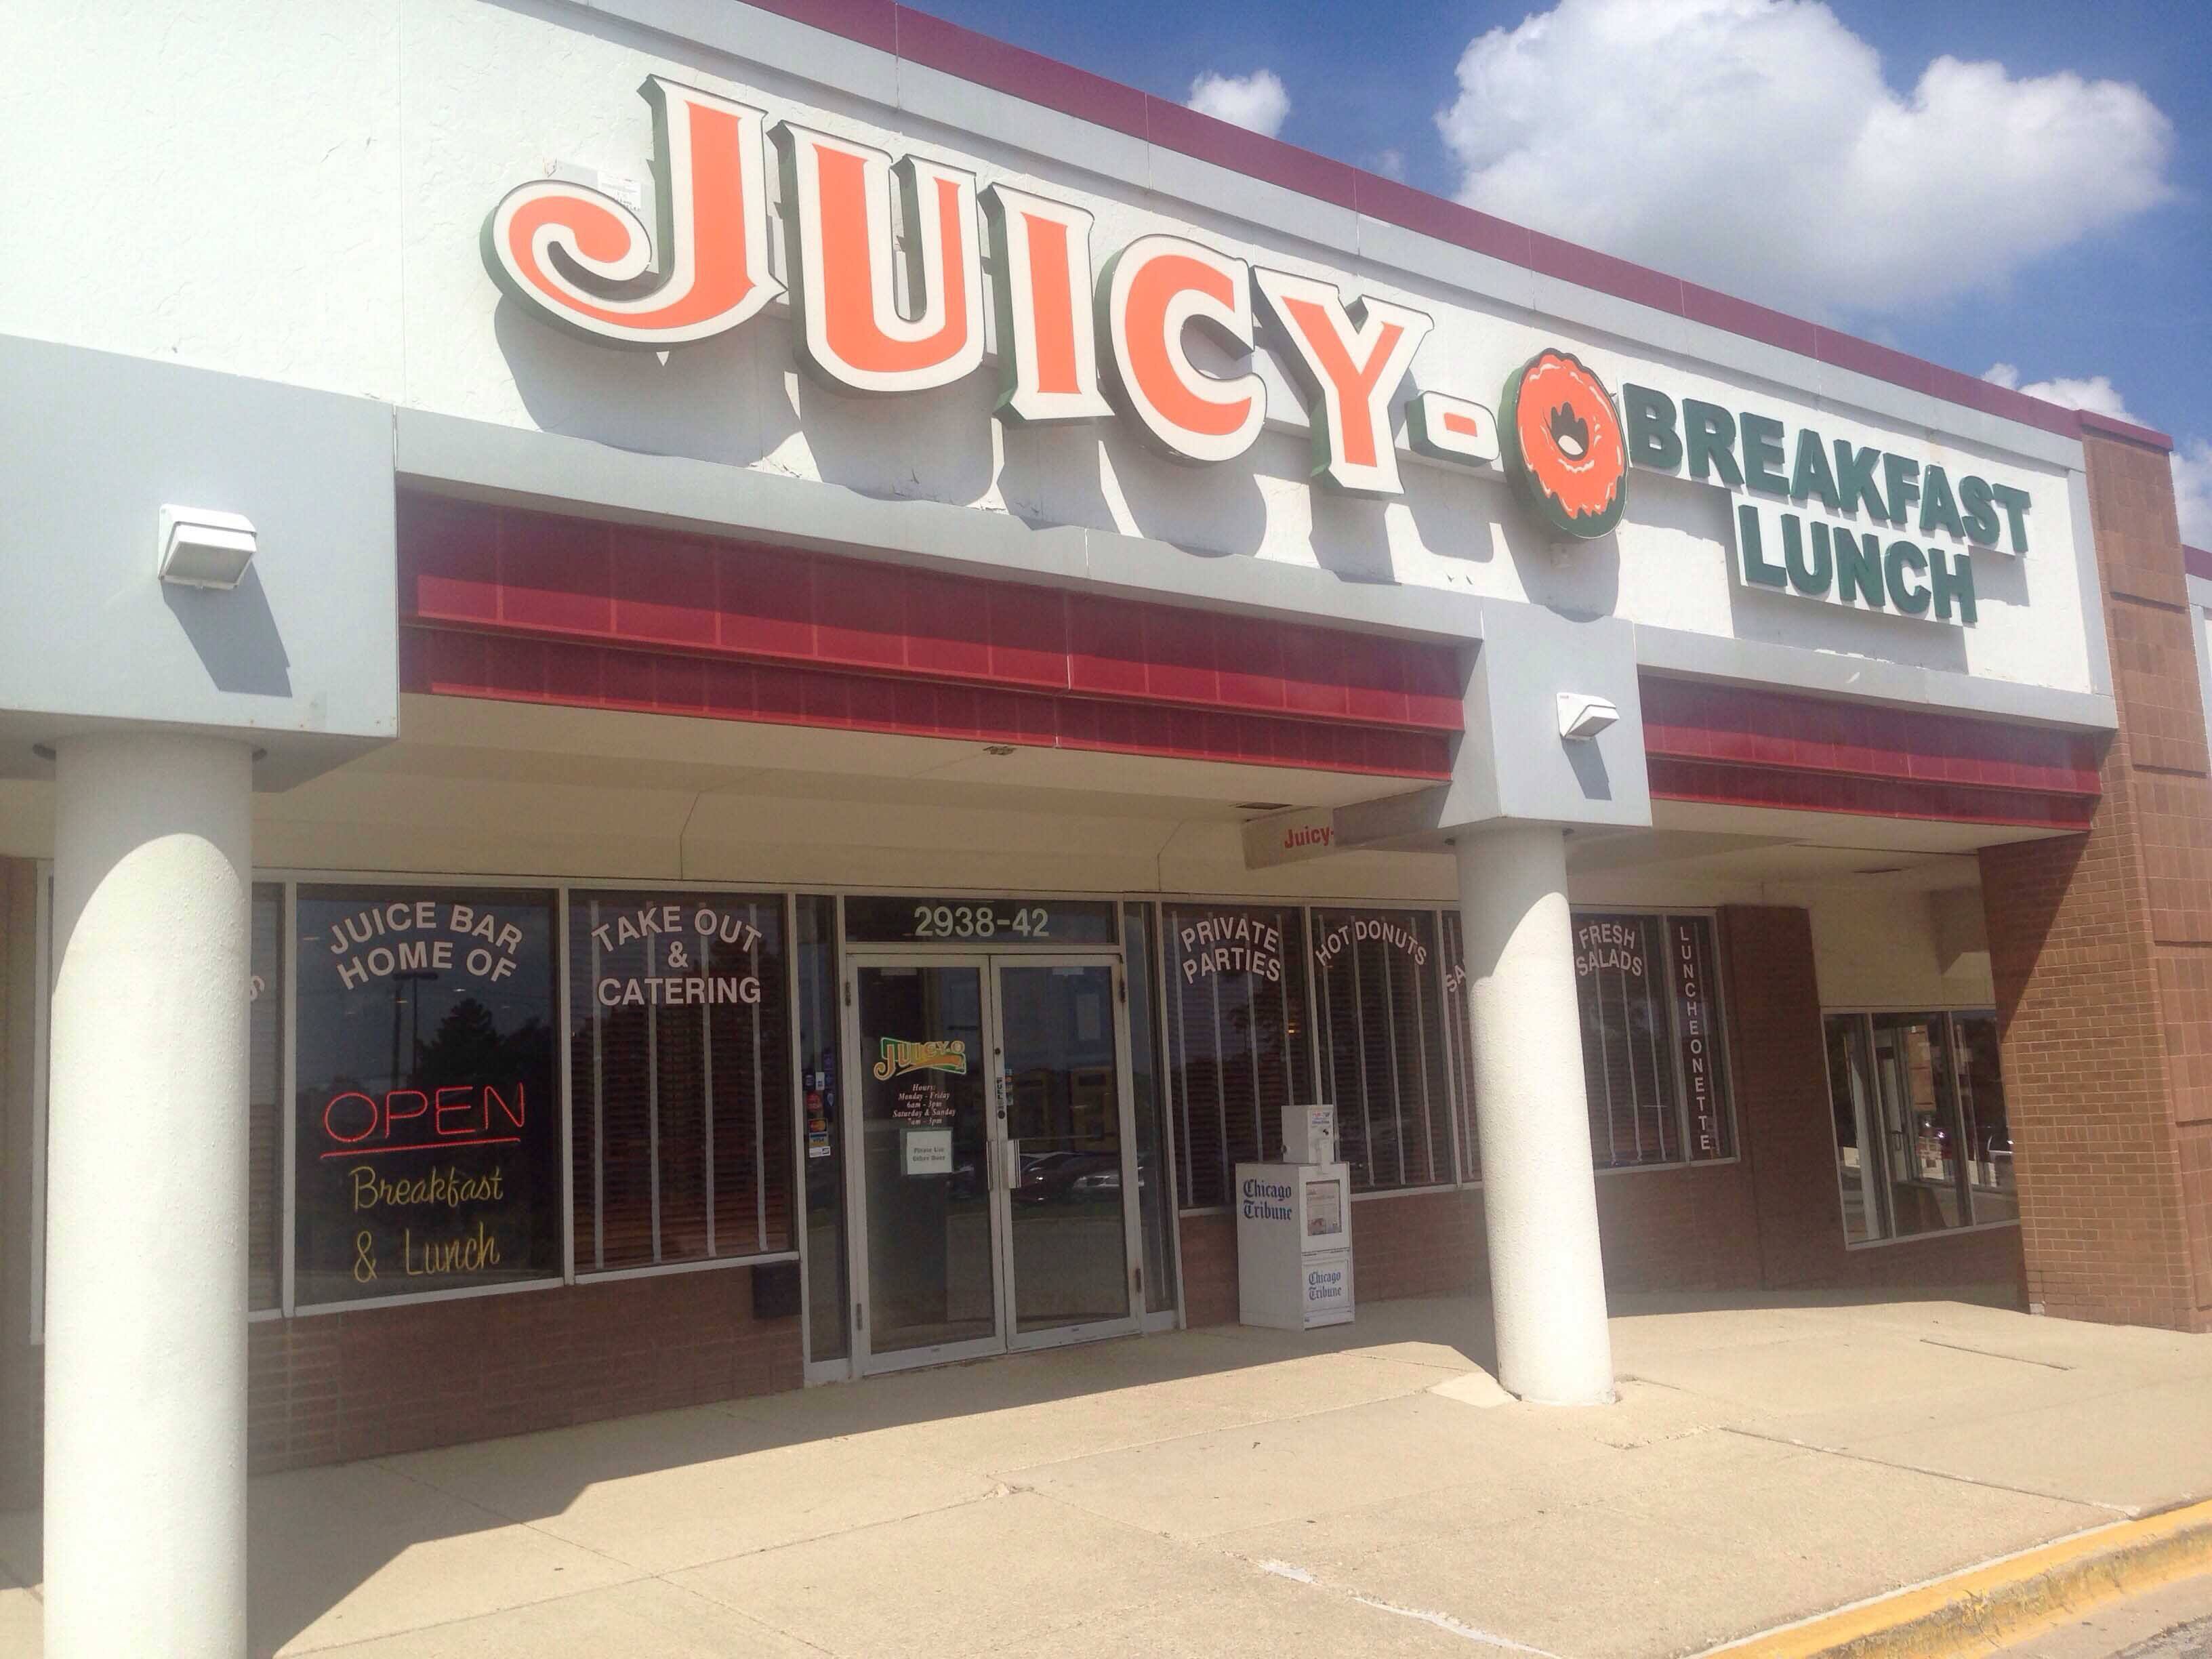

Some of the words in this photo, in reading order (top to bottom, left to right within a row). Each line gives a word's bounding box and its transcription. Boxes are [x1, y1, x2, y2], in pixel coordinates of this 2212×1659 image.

[1622, 382, 2031, 552] BREAKFAST
[1738, 504, 1978, 623] LUNCH
[329, 901, 437, 956] JUICE
[449, 905, 523, 954] BAR
[591, 906, 682, 953] TAKE
[694, 908, 762, 953] OUT
[914, 905, 1050, 937] 2938-42
[1181, 916, 1280, 953] PRIVATE
[1578, 922, 1636, 949] FRESH
[667, 941, 689, 968] &
[1315, 924, 1351, 966] HOT
[1355, 920, 1429, 966] DONUTS
[336, 941, 453, 991] HOME
[465, 947, 517, 983] OF
[1182, 949, 1282, 986] PARTIES
[1575, 949, 1643, 977] SALADS
[597, 977, 762, 1007] CATERING
[1679, 926, 1711, 1151] LUNCHEONETTE
[323, 1083, 526, 1143] OPEN
[893, 1109, 922, 1118] Saturday
[898, 1093, 924, 1101] Monday
[930, 1092, 951, 1100] Friday
[348, 1165, 504, 1211] Breakfast
[1243, 1179, 1292, 1202] Chicago
[1244, 1200, 1292, 1221] Tribune
[354, 1230, 377, 1283] &
[405, 1221, 500, 1277] Lunch
[1308, 1271, 1341, 1287] Chicago
[1309, 1286, 1342, 1301] Tribune
